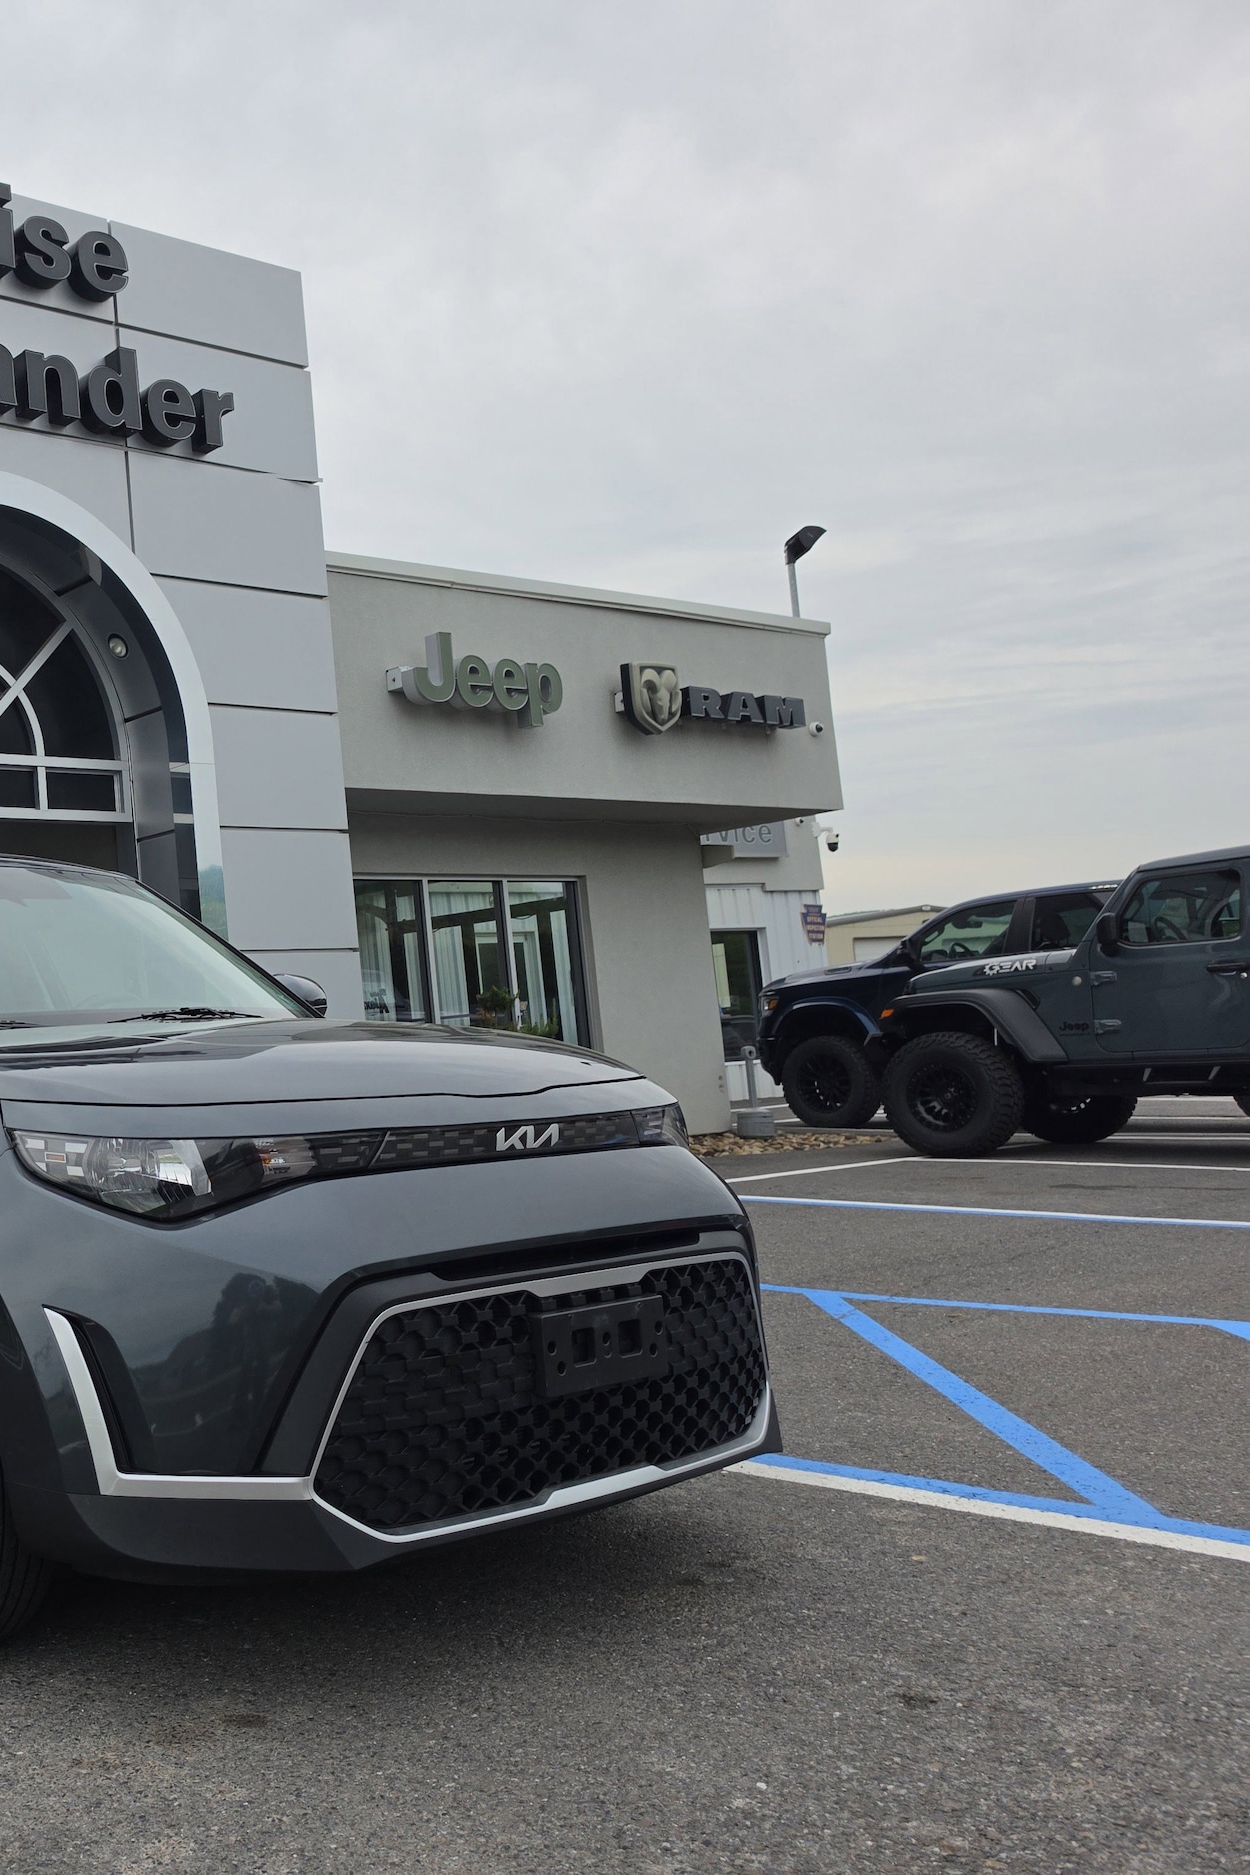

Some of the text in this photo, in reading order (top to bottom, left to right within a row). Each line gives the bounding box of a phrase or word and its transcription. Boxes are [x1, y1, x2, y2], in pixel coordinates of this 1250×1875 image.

[402, 631, 563, 728] Jeep
[682, 685, 806, 729] RAM
[983, 959, 1037, 976] GEAR
[1059, 1021, 1089, 1032] Jeep
[496, 1123, 559, 1151] KIA
